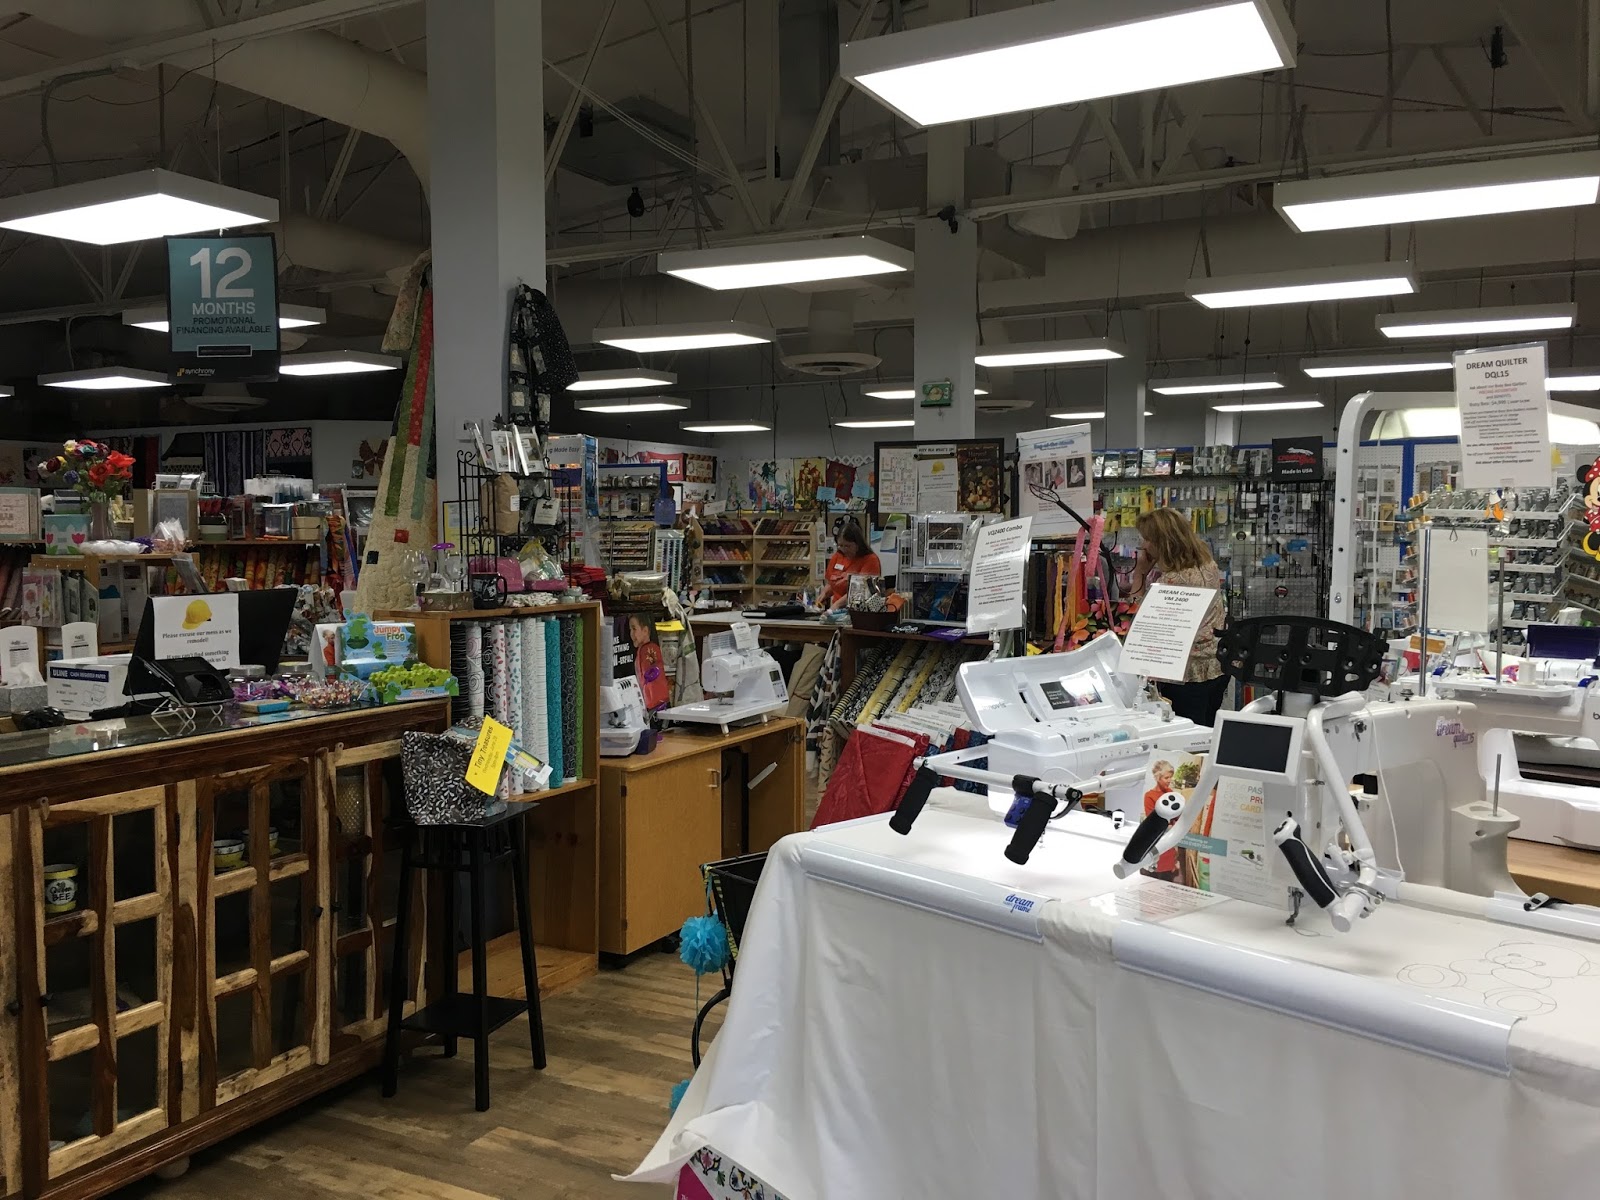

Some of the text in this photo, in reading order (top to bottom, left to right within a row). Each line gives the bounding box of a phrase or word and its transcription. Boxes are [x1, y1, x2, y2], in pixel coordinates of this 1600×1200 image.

[190, 247, 254, 299] 12
[192, 302, 255, 315] MONTHS
[193, 317, 255, 325] PROMOTIONAL
[176, 325, 271, 334] FINANCING AVAILABLE
[1466, 357, 1528, 370] DREAM QUILTER
[1484, 370, 1509, 379] DQL15
[374, 625, 401, 634] Jumpy
[386, 632, 405, 641] Frog
[52, 669, 68, 677] ULINE
[474, 725, 494, 769] Tiny Treasures
[1005, 893, 1035, 908] dream
